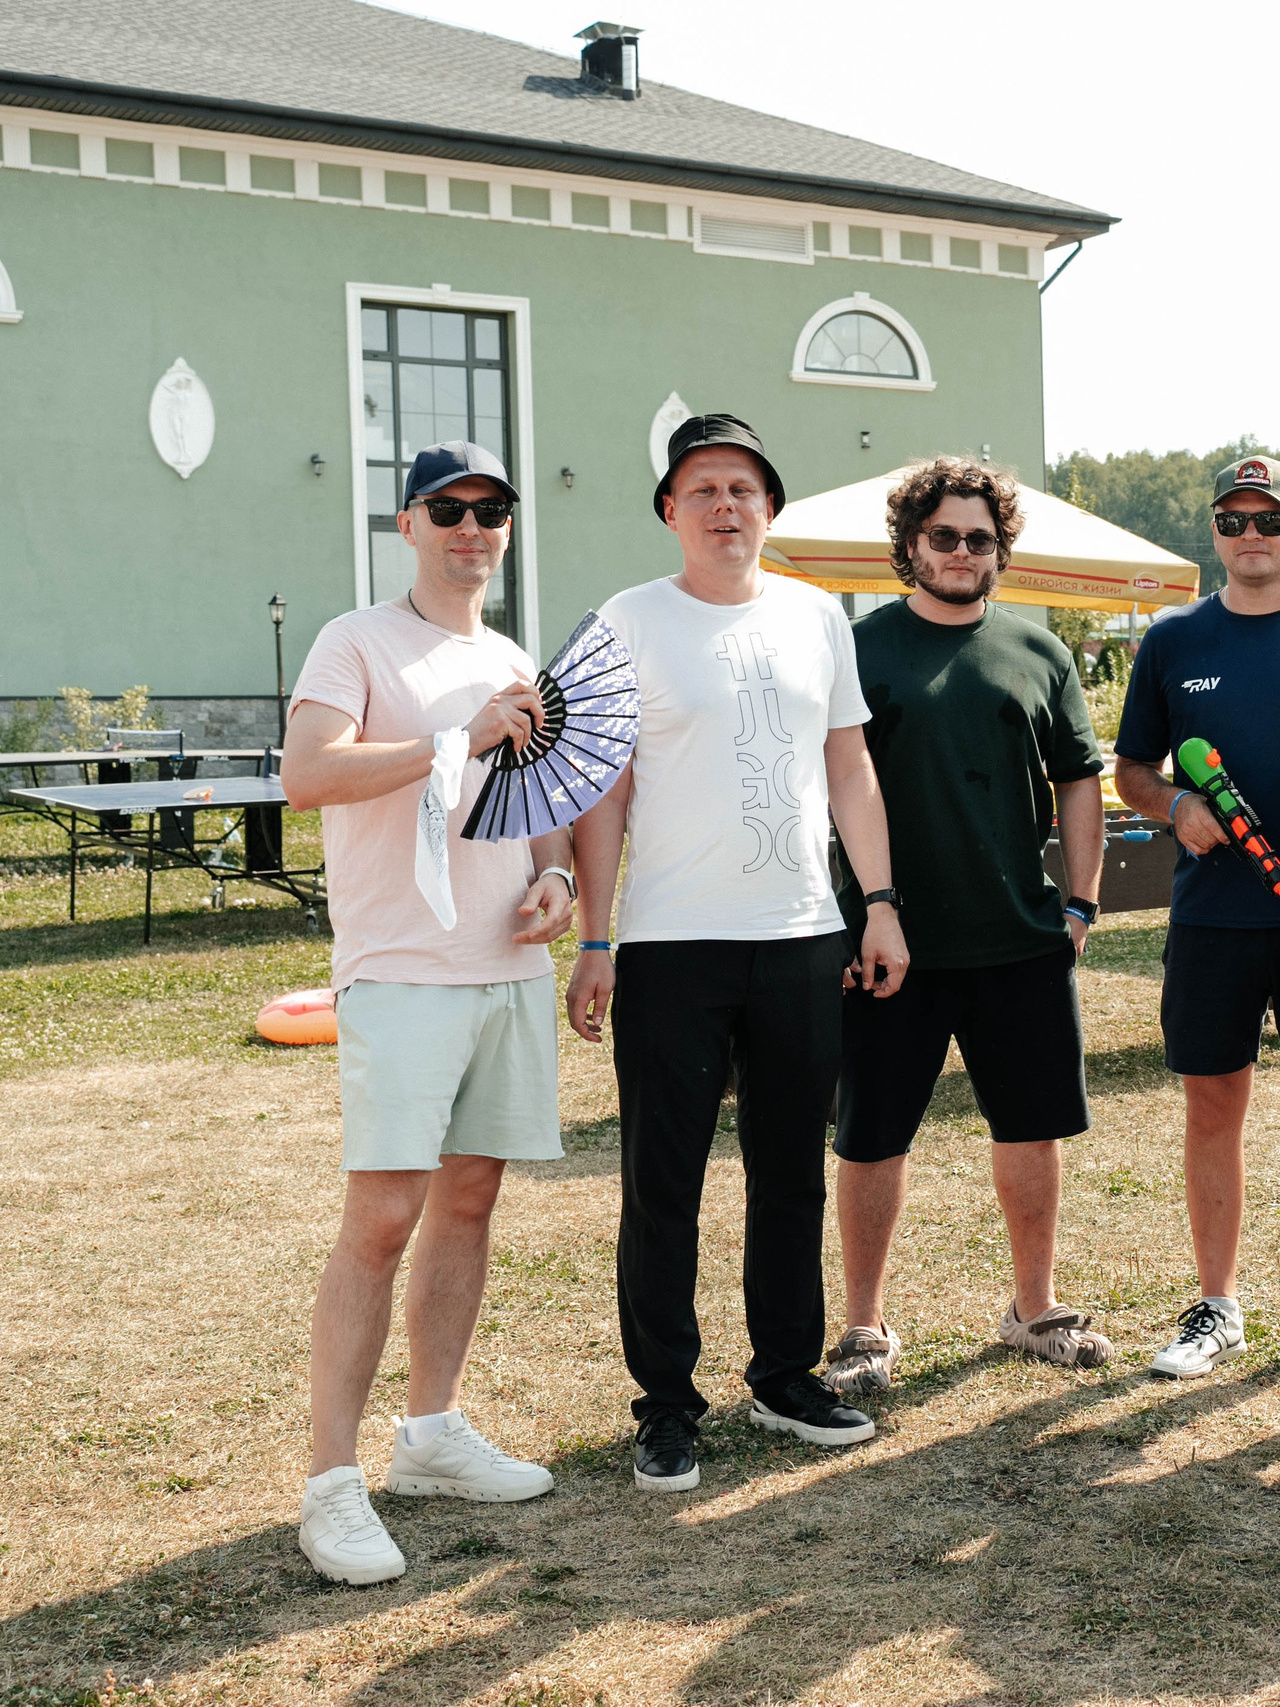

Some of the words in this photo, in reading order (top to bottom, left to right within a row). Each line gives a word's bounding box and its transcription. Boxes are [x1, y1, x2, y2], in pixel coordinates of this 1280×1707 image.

[1018, 575, 1078, 591] ОТКРОЙСЯ
[1081, 583, 1121, 596] ЖИЗНИ
[1135, 579, 1158, 588] Lipton
[1181, 676, 1221, 693] RAY
[119, 807, 157, 816] DONIC
